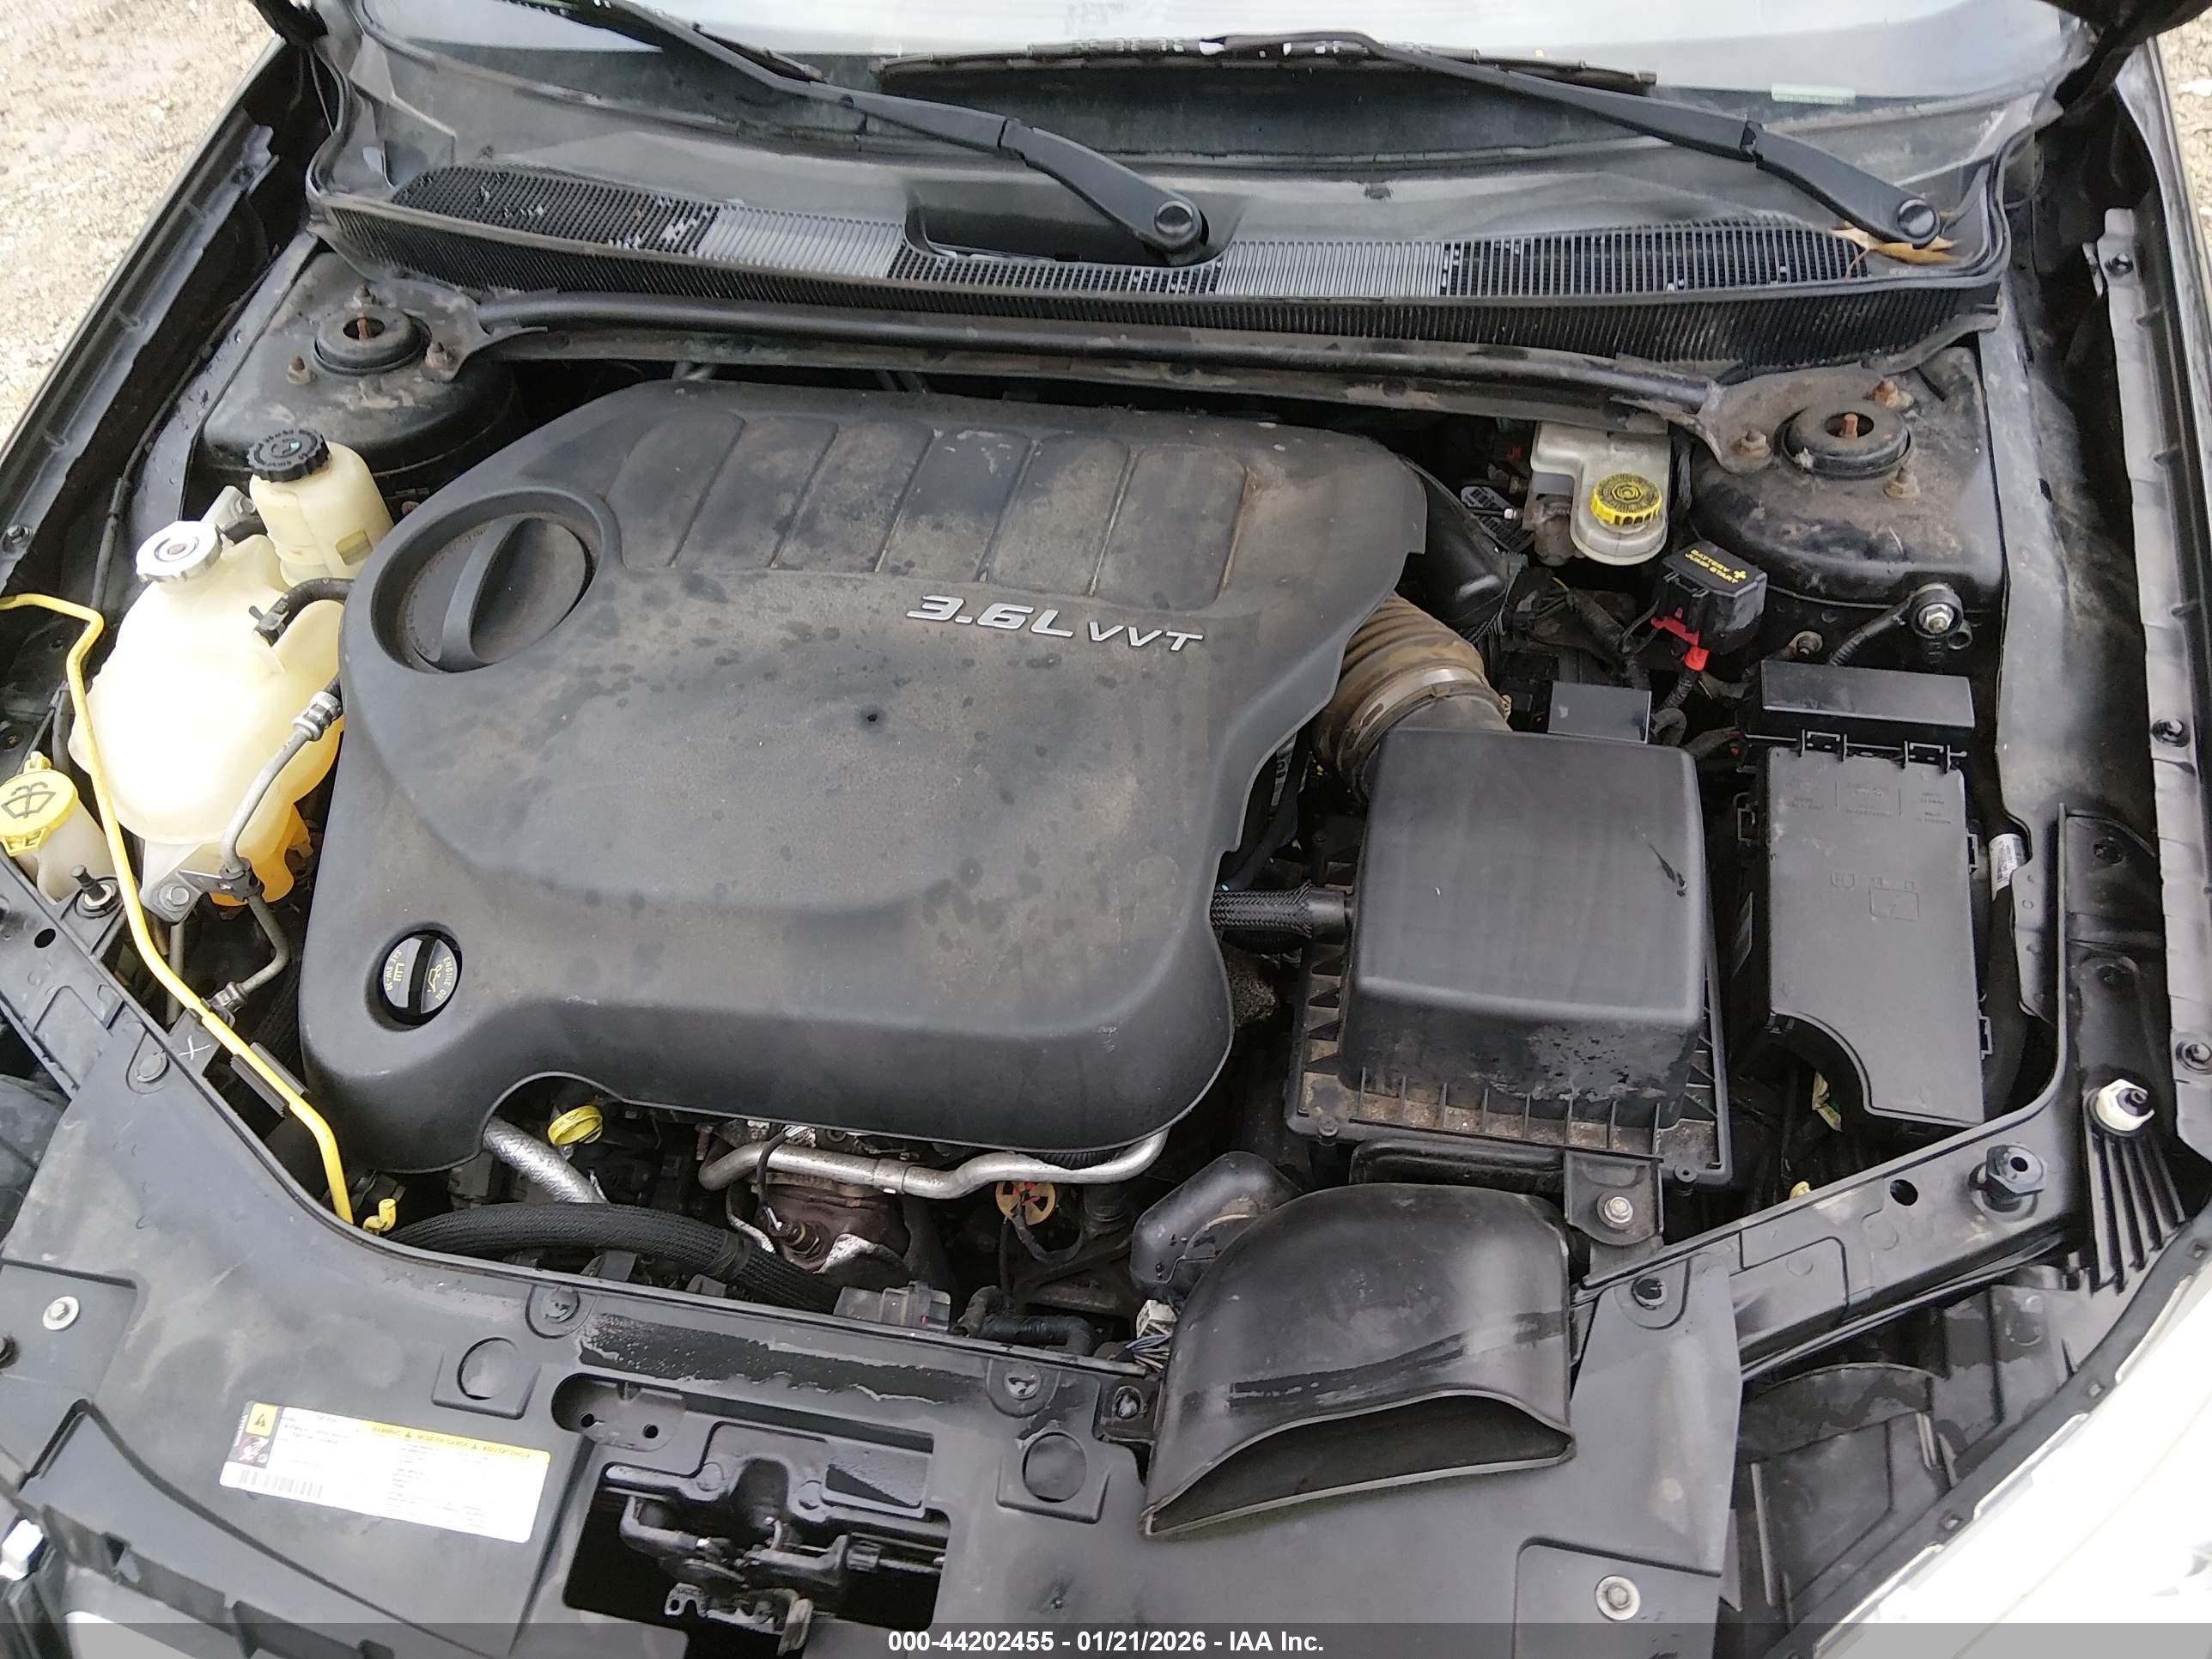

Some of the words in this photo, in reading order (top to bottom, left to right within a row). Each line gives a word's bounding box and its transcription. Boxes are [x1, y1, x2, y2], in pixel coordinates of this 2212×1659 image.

[1690, 549, 1731, 572] BATTERY
[1709, 566, 1739, 584] START
[906, 594, 1074, 638] 3.6L
[1088, 621, 1205, 653] VVT
[390, 949, 402, 963] SAE
[443, 956, 453, 986] ENGINE
[434, 989, 447, 1001] OIL
